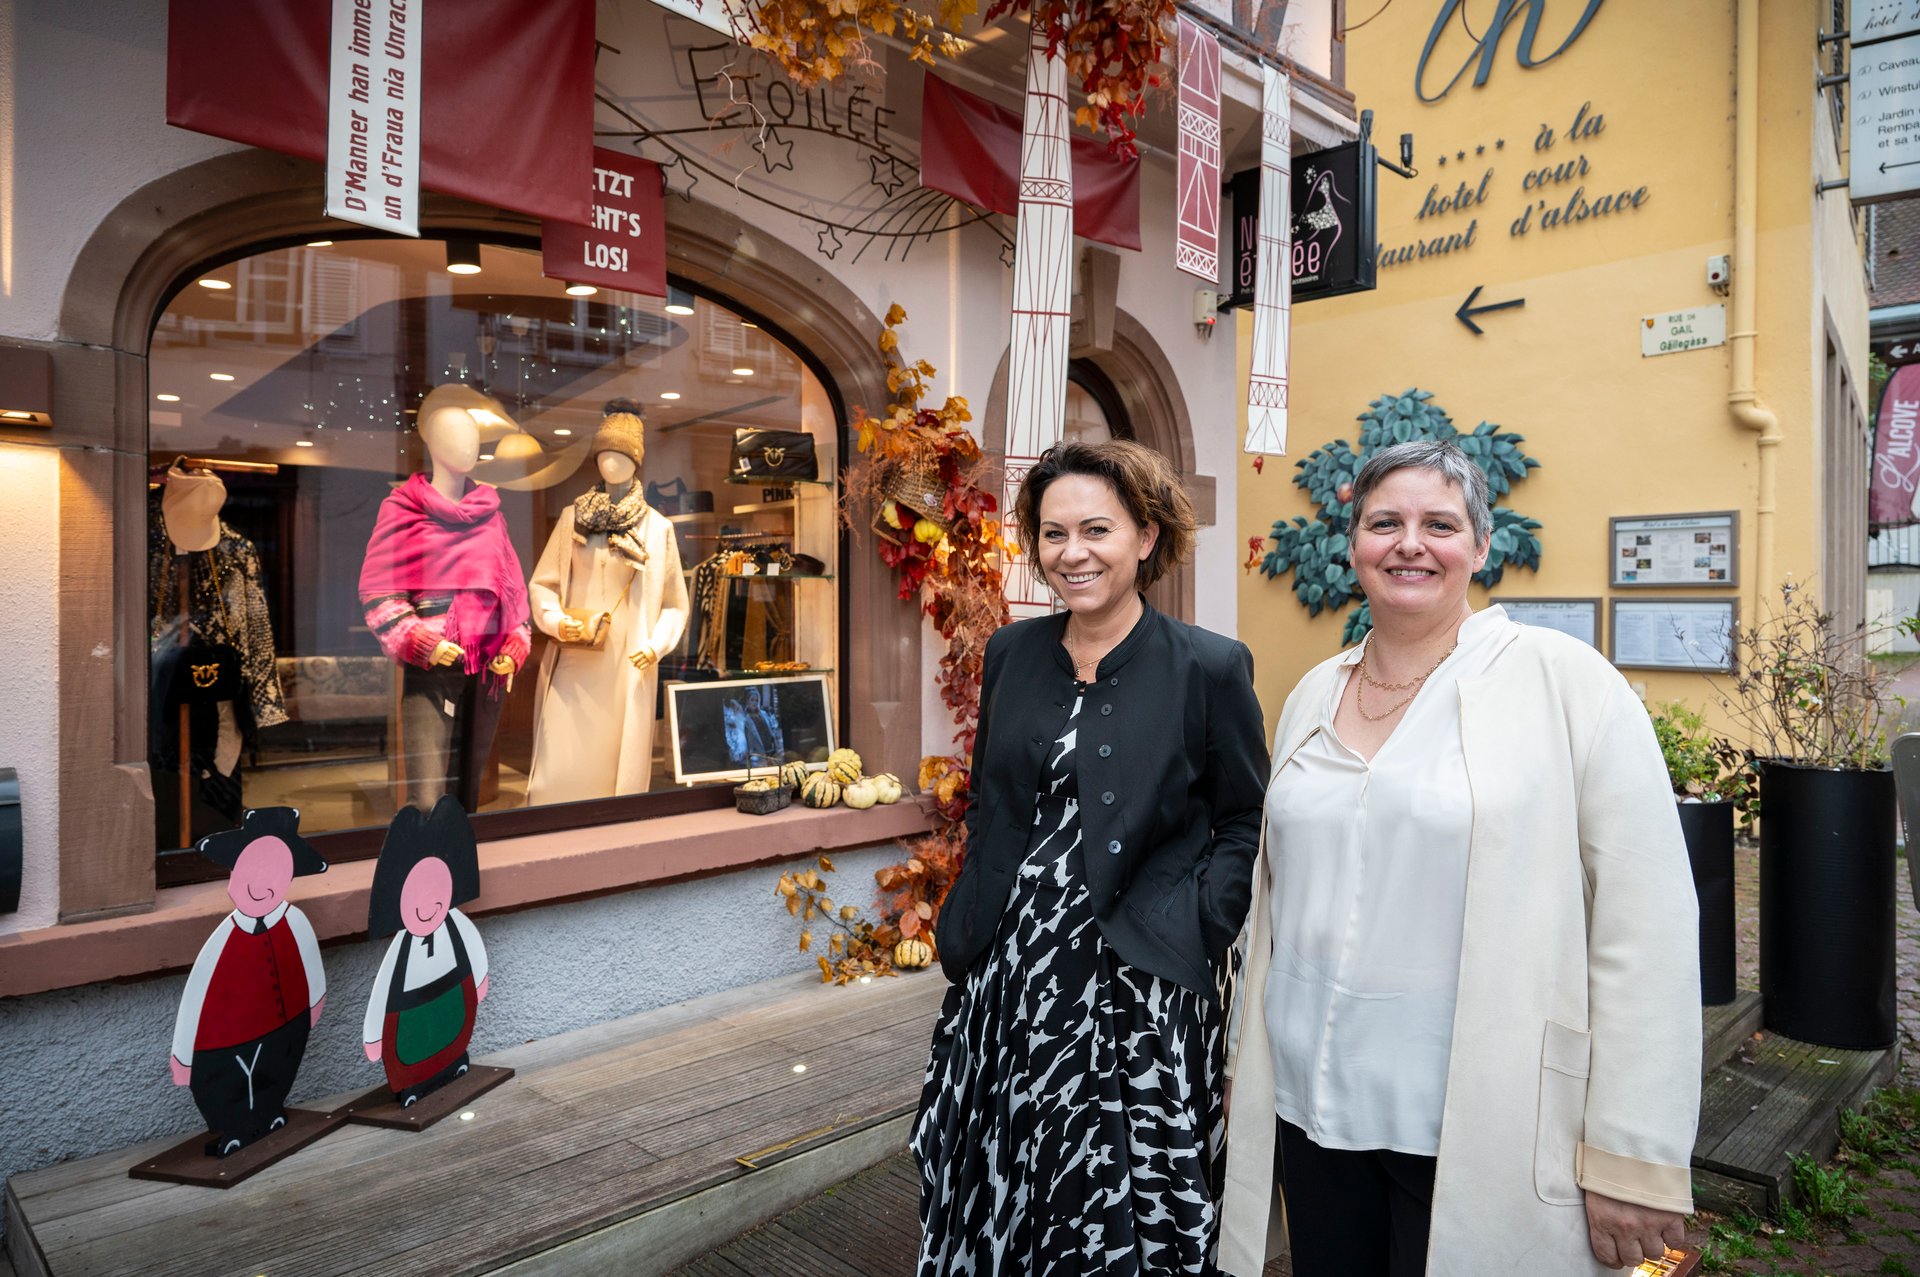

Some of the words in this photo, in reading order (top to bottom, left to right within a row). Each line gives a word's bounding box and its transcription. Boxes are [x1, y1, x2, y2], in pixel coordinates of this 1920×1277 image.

[384, 0, 406, 60] Unrac
[1862, 10, 1902, 32] hotel
[348, 63, 369, 103] han
[383, 67, 404, 100] nia
[1879, 80, 1920, 97] Winstu
[1534, 123, 1555, 152] à
[1565, 100, 1607, 142] la
[1878, 107, 1914, 122] Jardin
[381, 107, 404, 187] d'Fraua
[1878, 138, 1889, 148] et
[1894, 136, 1908, 146] sa
[345, 109, 368, 212] D'Manner
[1522, 154, 1592, 192] cour
[592, 167, 634, 198] TZT
[1415, 167, 1494, 221] hotel
[385, 195, 402, 220] un
[1509, 185, 1651, 238] d'alsace
[584, 241, 628, 272] LOS!
[1376, 219, 1478, 270] taurant
[1668, 313, 1682, 323] RUE
[1671, 324, 1693, 336] GAIL
